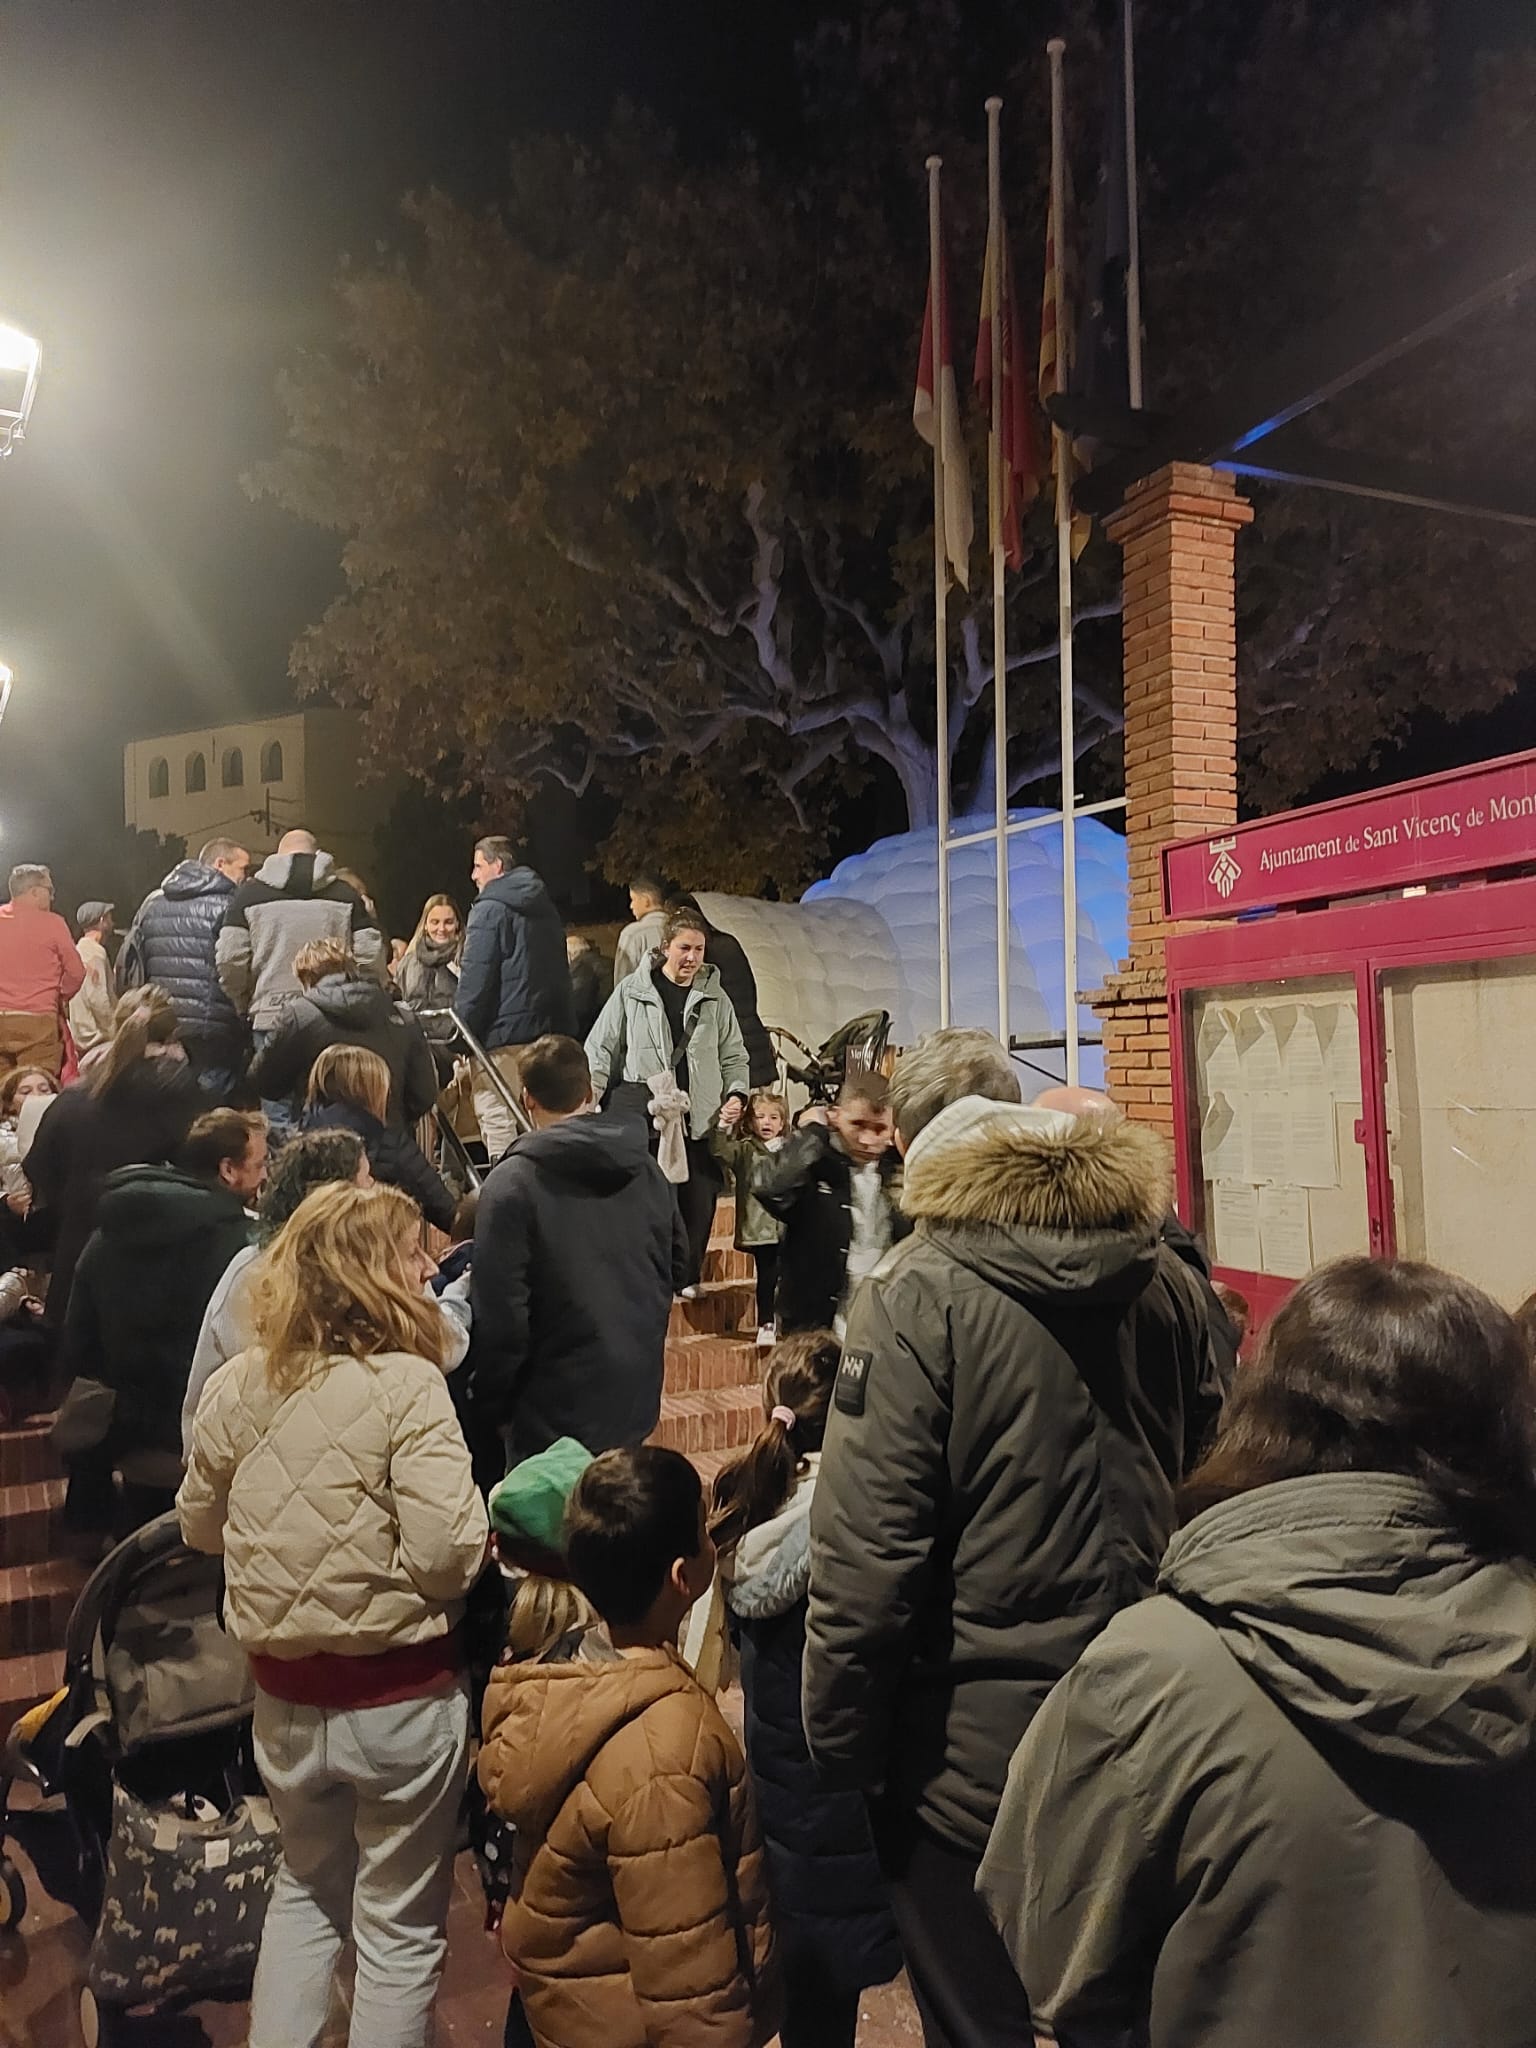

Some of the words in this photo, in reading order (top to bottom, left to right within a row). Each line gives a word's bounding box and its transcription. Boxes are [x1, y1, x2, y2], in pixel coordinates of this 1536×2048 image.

[1259, 837, 1342, 875] Ajuntament
[1345, 835, 1360, 854] de
[1363, 825, 1398, 850] Sant
[1402, 812, 1461, 840] Vicenç
[1466, 807, 1485, 828] de
